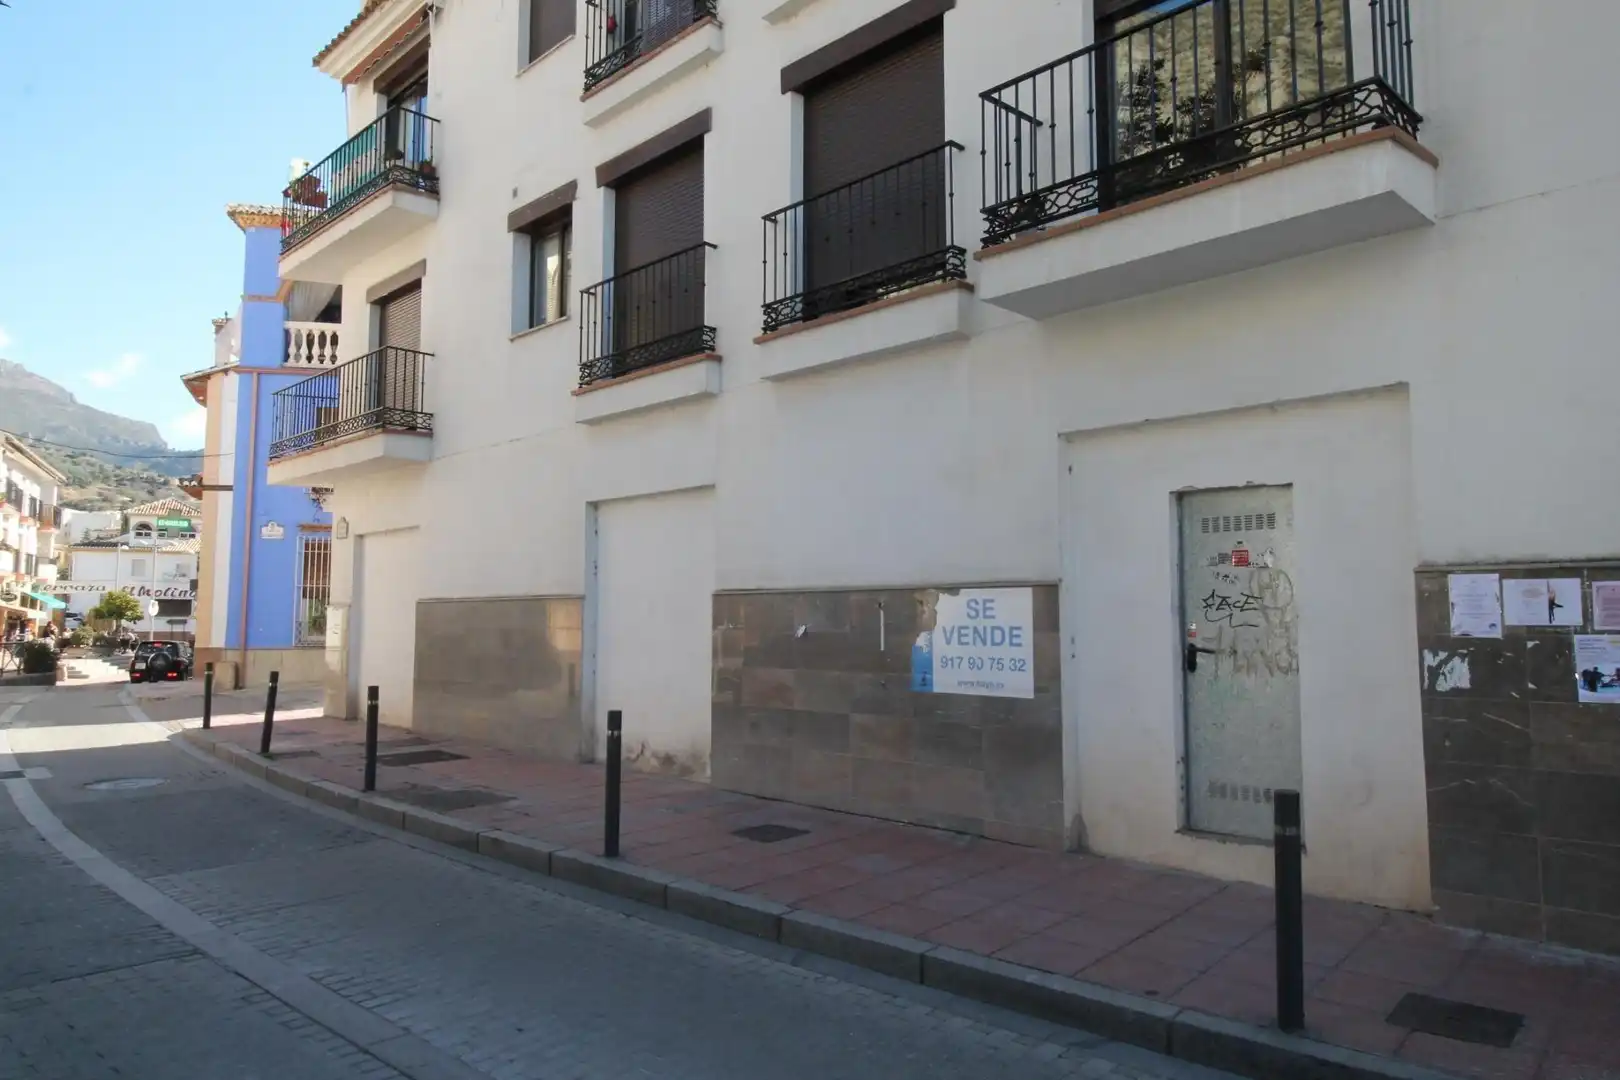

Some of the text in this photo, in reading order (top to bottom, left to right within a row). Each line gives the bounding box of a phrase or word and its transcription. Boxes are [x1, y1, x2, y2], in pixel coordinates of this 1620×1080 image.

[967, 599, 996, 619] SE
[942, 625, 1023, 647] VENDE
[940, 655, 1027, 672] 917 90 75 32
